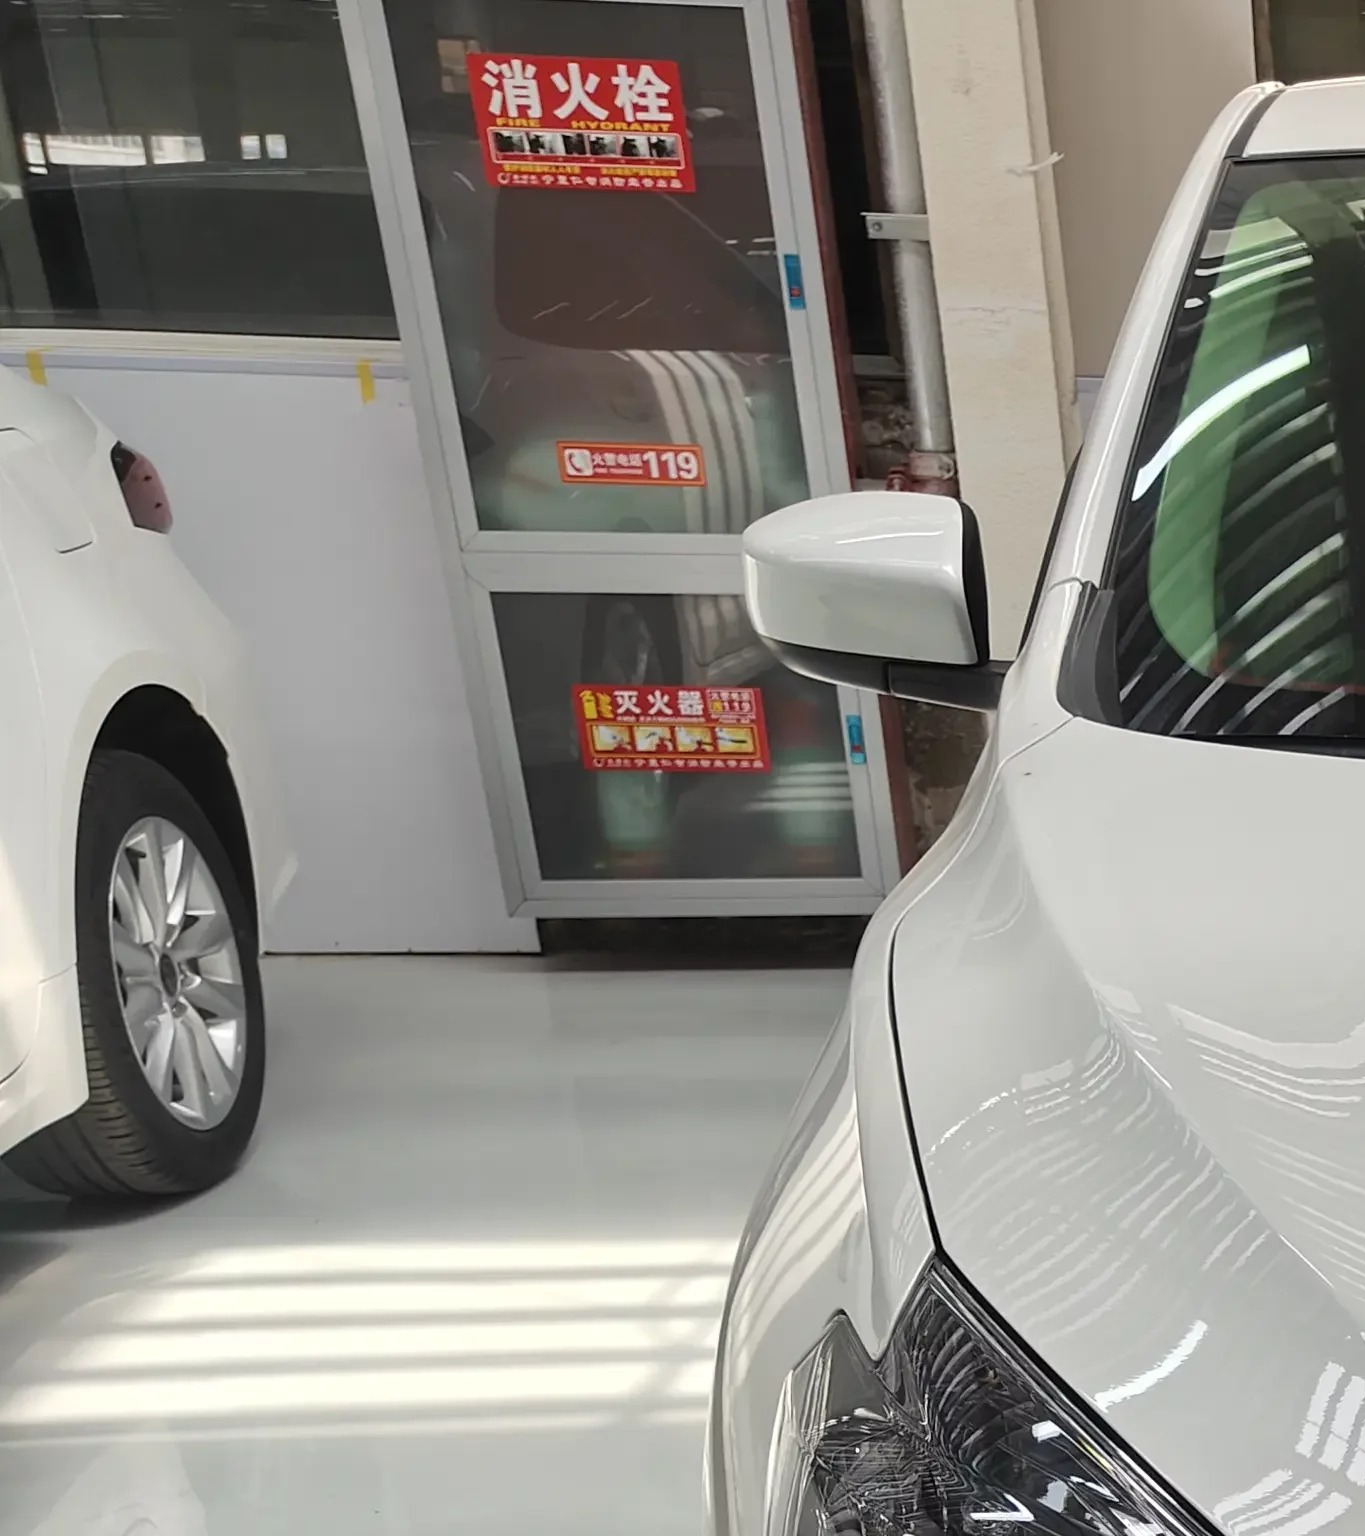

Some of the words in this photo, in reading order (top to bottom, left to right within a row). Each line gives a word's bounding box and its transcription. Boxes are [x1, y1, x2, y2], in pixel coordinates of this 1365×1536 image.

[481, 58, 674, 122] 消火栓
[495, 117, 541, 128] FIRE
[571, 120, 670, 132] HYDRANT
[642, 450, 699, 480] 119
[613, 689, 705, 716] 灭火器
